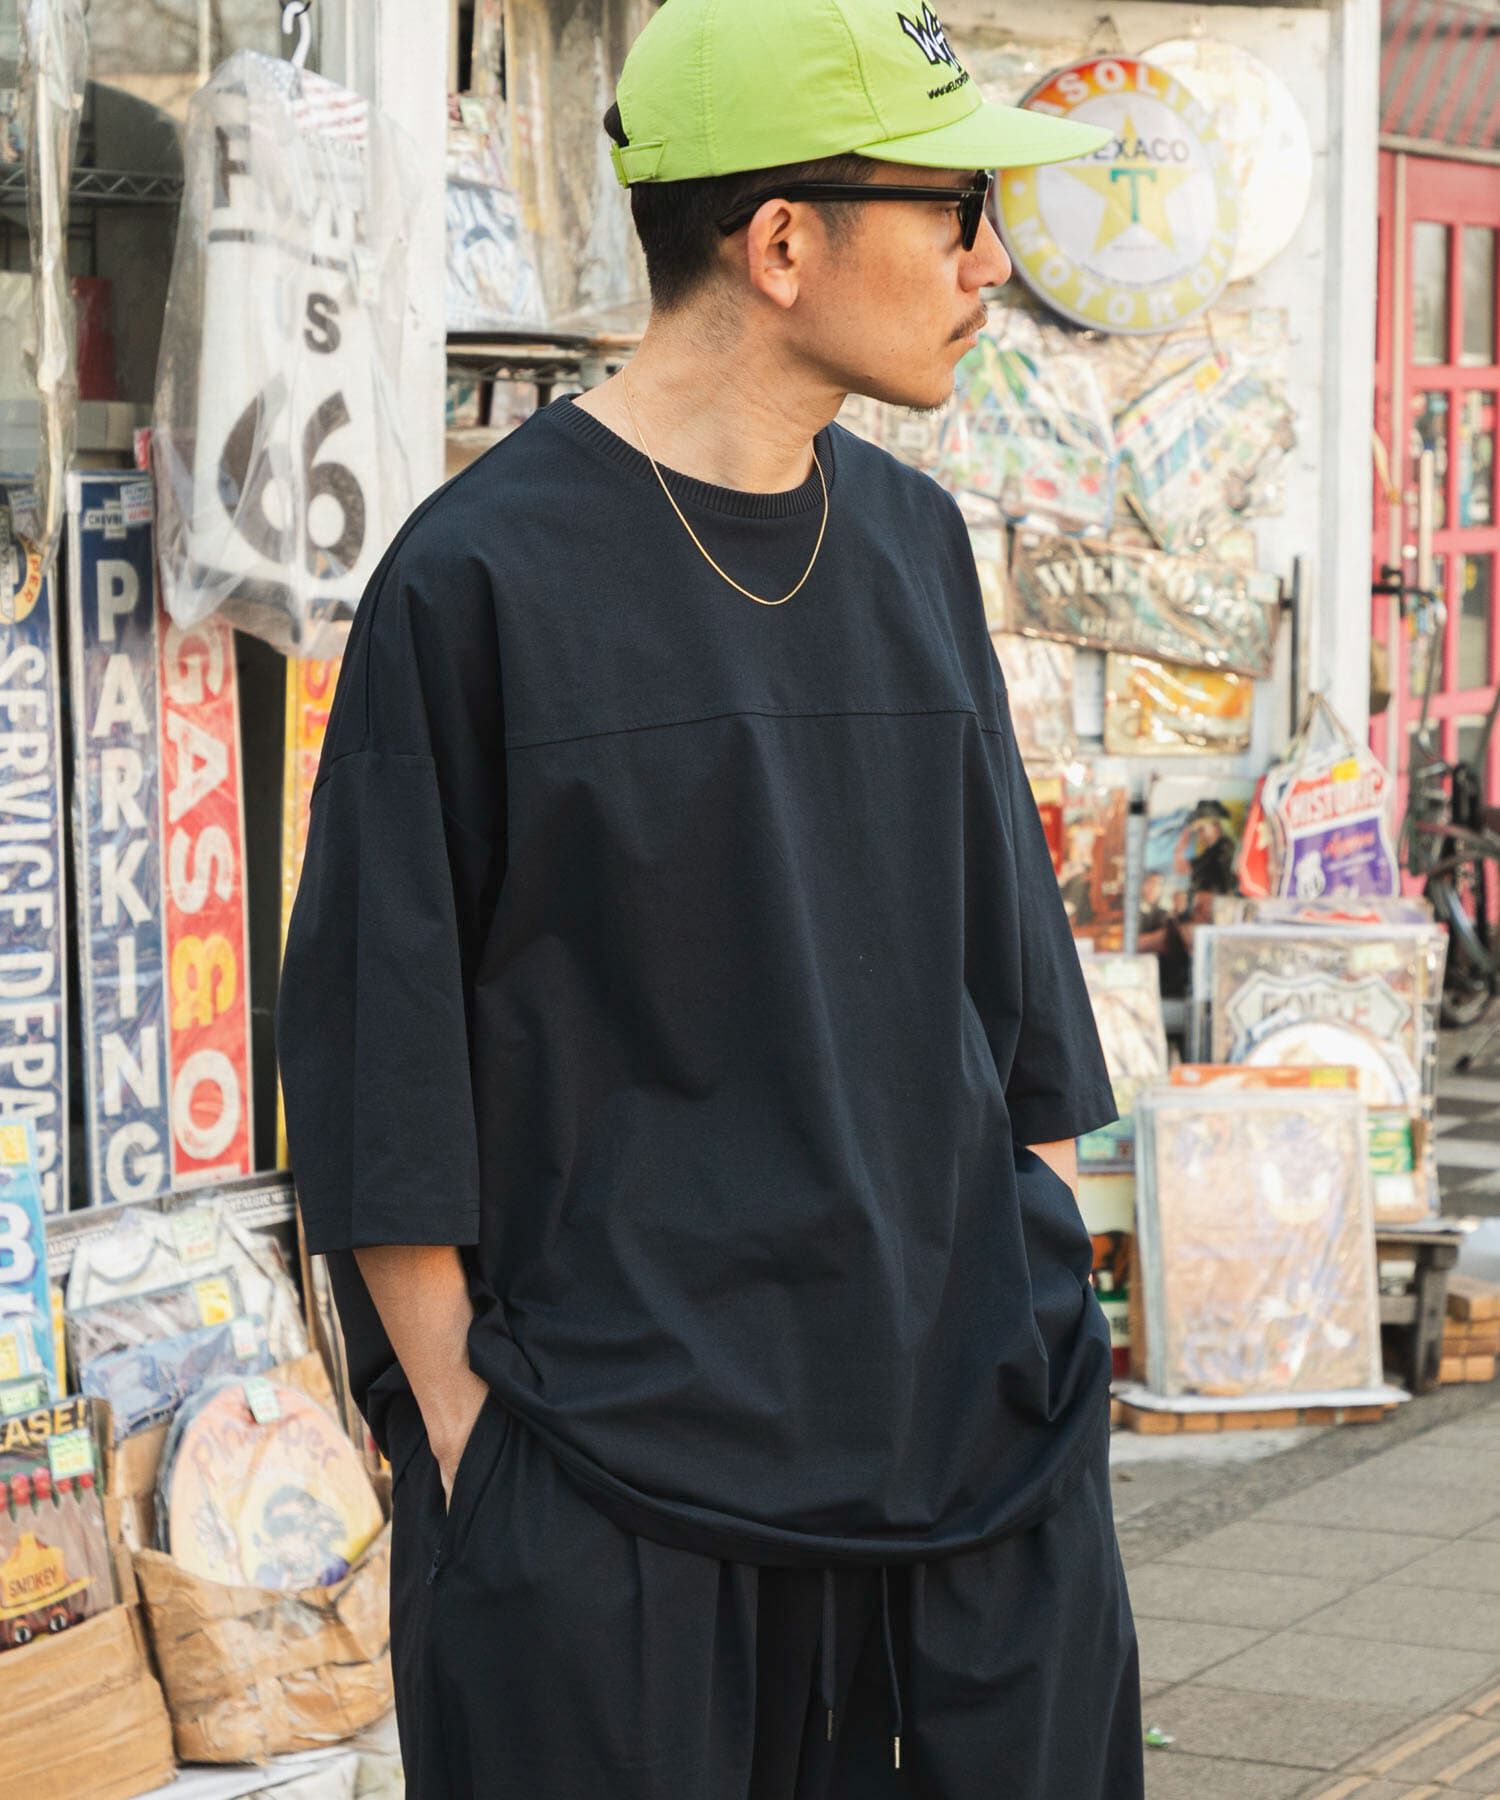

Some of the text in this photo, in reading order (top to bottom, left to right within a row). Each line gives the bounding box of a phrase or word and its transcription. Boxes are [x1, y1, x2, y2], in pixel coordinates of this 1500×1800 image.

[1079, 137, 1190, 163] EXACO
[162, 622, 235, 915] GAS
[91, 559, 165, 1202] PARKING
[0, 1399, 86, 1453] ASE!
